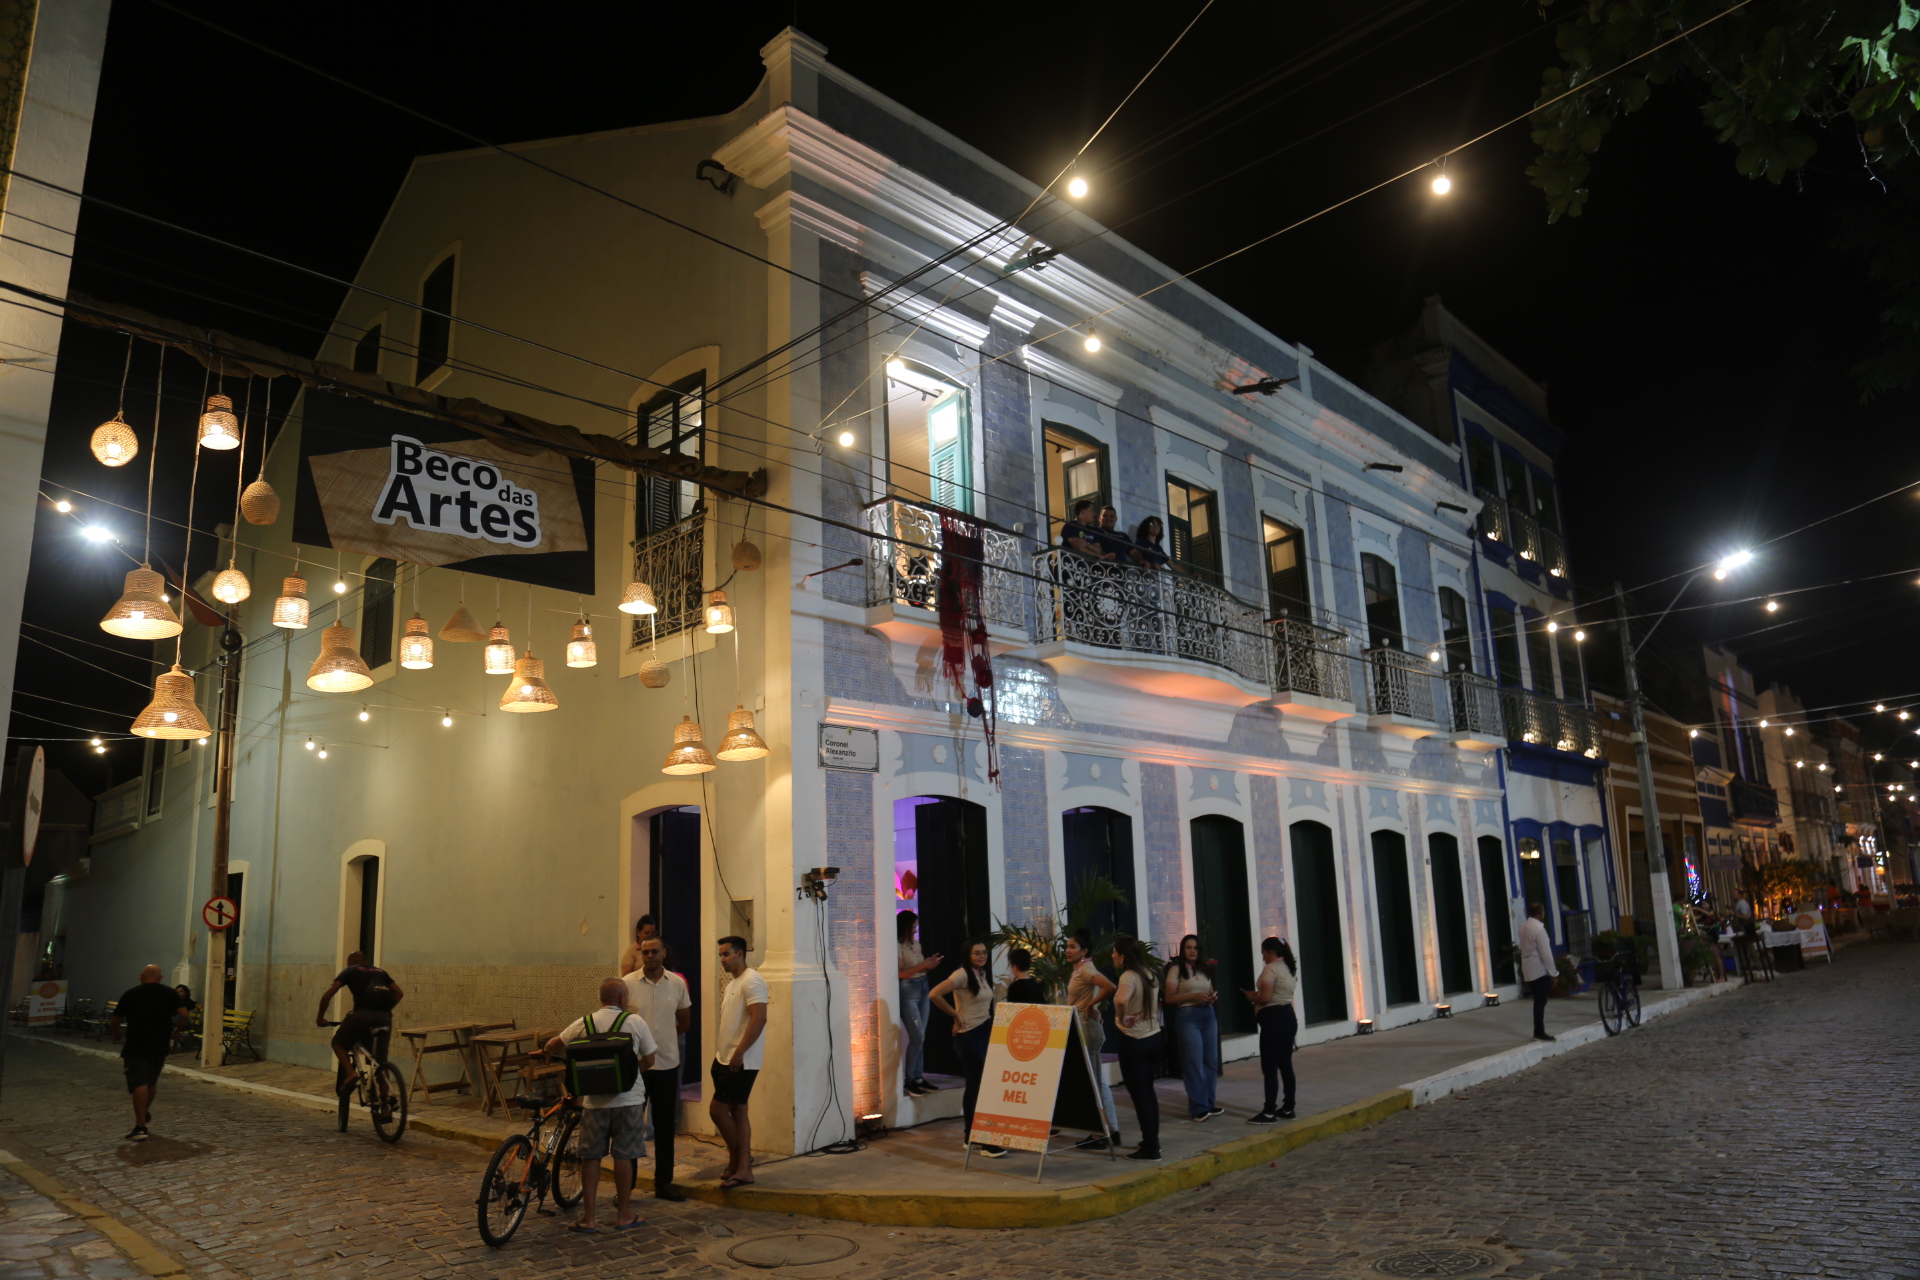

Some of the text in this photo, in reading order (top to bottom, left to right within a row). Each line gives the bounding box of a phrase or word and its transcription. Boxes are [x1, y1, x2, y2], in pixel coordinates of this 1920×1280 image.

[396, 441, 533, 507] Beco das
[378, 474, 538, 543] Artes
[825, 739, 849, 748] Coronel
[825, 747, 857, 757] Alexanzito
[1002, 1070, 1038, 1086] DOCE
[1002, 1090, 1028, 1104] MEL
